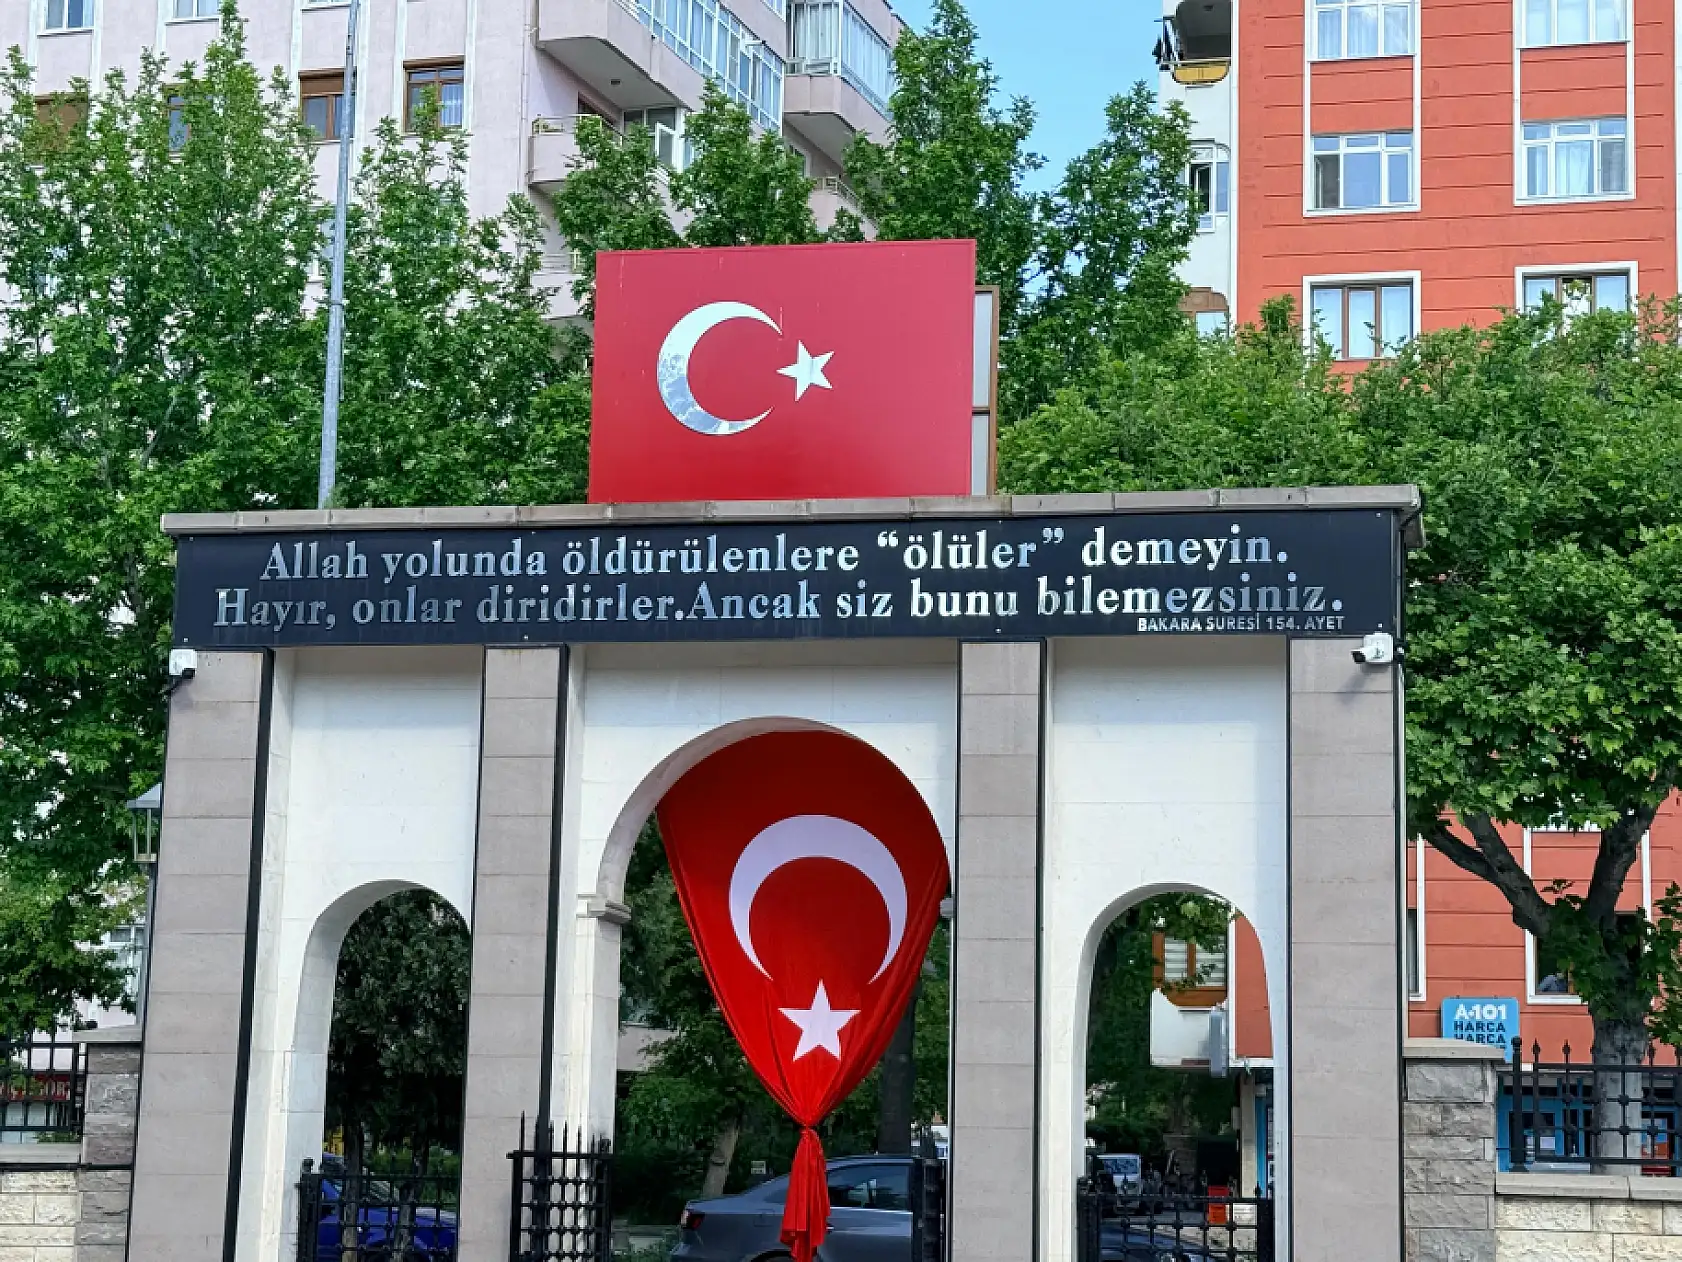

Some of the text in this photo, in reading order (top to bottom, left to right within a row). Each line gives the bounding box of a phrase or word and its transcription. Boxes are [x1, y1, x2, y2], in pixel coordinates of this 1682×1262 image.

[260, 538, 369, 583] Allah
[380, 536, 548, 587] yolunda
[562, 533, 860, 578] öldürülenlere
[1081, 523, 1289, 575] demeyin.
[213, 587, 337, 632] Hayır,
[352, 583, 462, 625] onlar
[836, 578, 893, 620] siz
[910, 576, 1018, 620] bunu
[1037, 571, 1343, 616] bilemezsiniz.
[1136, 616, 1202, 632] BAKARA
[1265, 615, 1300, 631] 154.
[1304, 615, 1346, 631] AYET
[1453, 1020, 1506, 1033] HARCA
